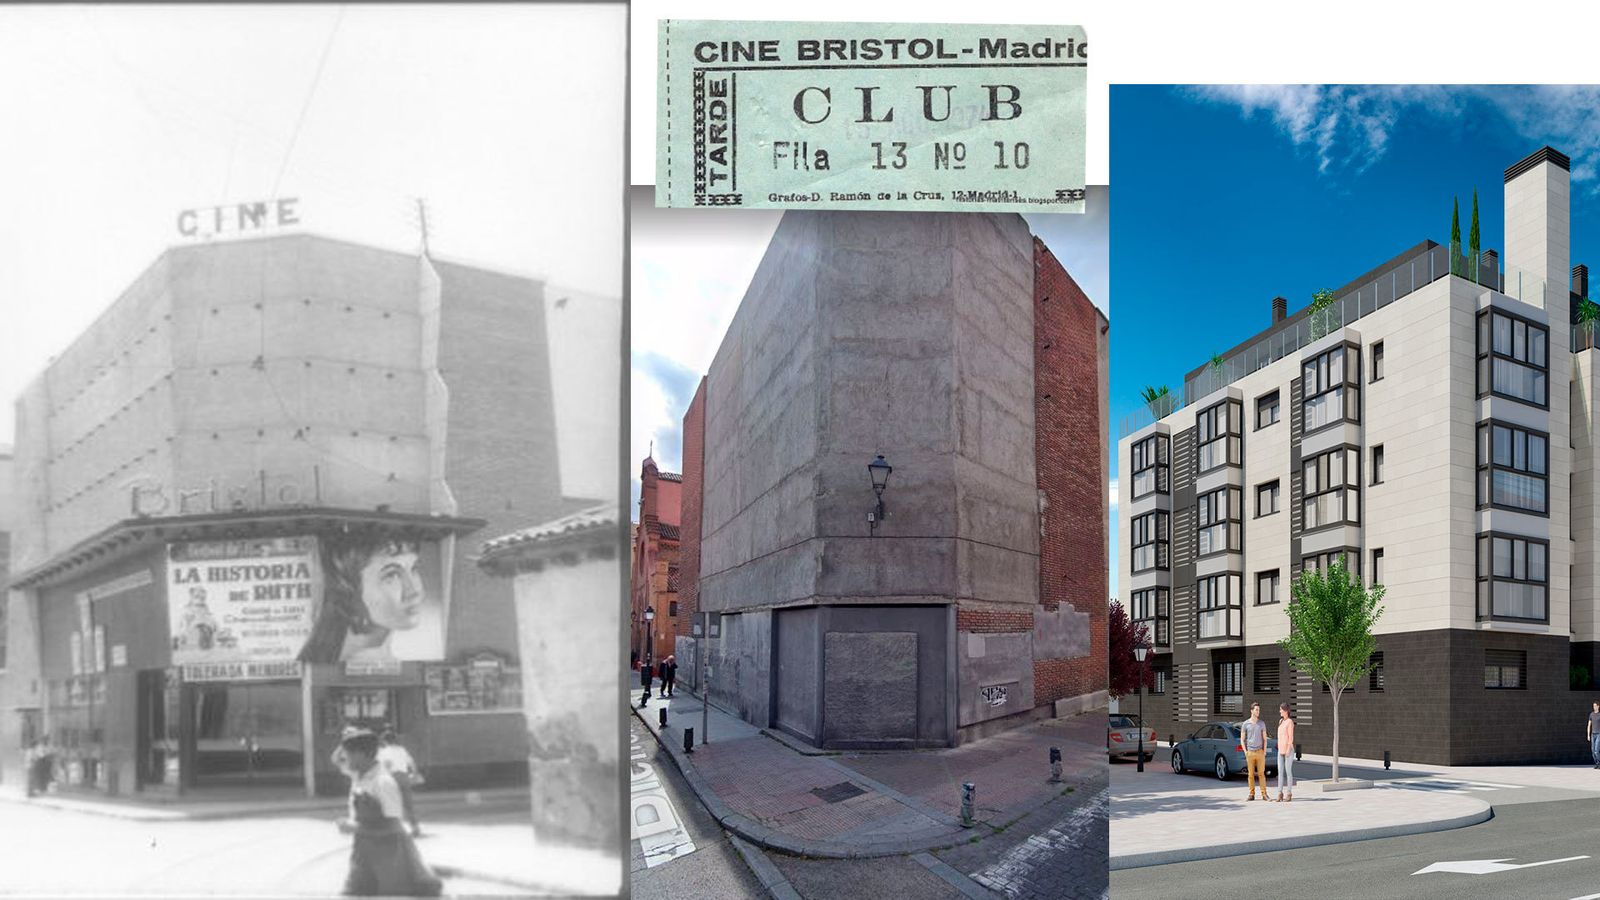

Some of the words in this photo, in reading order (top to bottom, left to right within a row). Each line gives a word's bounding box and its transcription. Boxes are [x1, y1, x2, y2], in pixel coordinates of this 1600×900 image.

[693, 40, 781, 63] CINE
[793, 84, 1023, 124] CLUB
[708, 78, 728, 187] TARDE
[773, 141, 831, 171] Fila
[871, 141, 907, 170] 13
[993, 141, 1030, 170] 10
[830, 191, 871, 201] Ramón
[877, 192, 891, 201] de
[897, 191, 907, 201] la
[177, 197, 299, 236] CINE
[174, 568, 200, 584] LA
[207, 563, 310, 582] HISTORIA
[253, 583, 311, 601] RUTH
